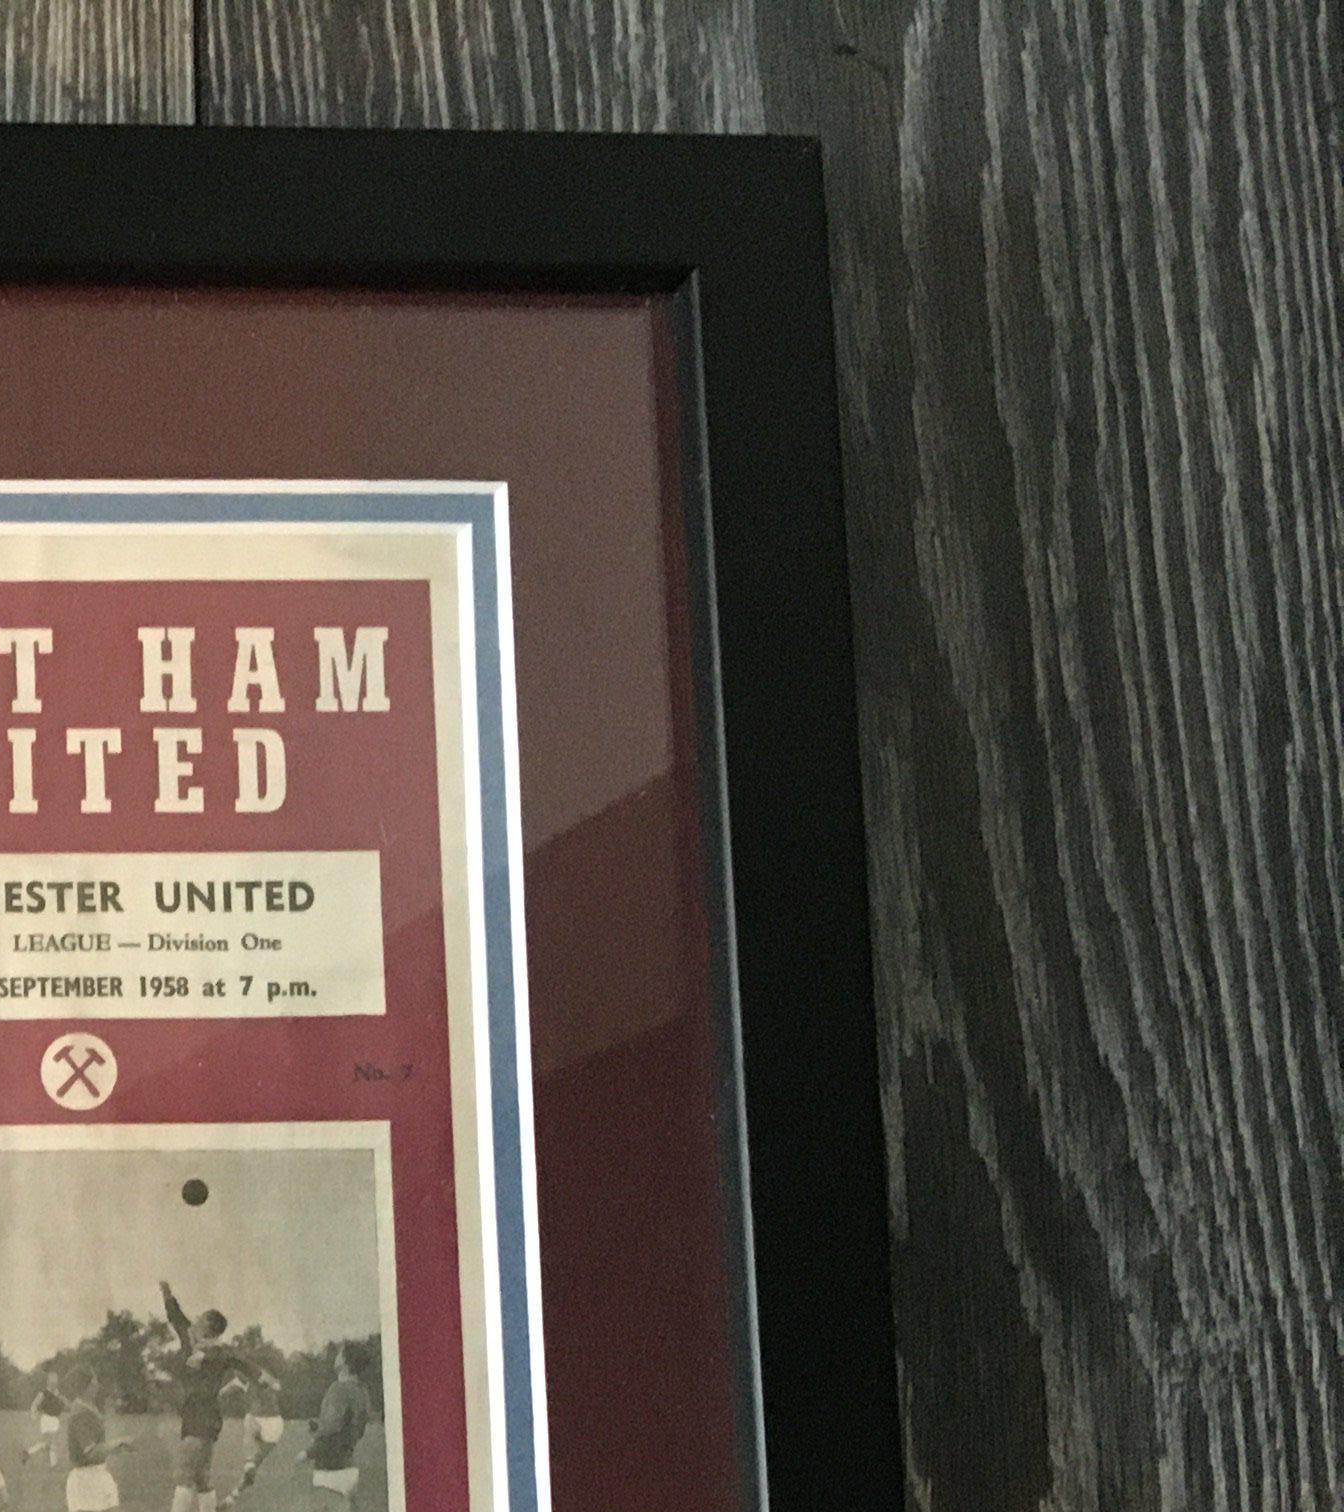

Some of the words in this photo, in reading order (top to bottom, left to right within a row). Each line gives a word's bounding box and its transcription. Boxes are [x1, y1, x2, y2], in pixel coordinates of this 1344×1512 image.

[136, 625, 392, 714] HAM
[153, 878, 316, 914] UNITED
[13, 932, 112, 953] LEAGUE
[147, 932, 230, 953] Division
[239, 932, 283, 952] One
[138, 975, 190, 999] 1958
[201, 978, 227, 999] at
[238, 974, 255, 997] 7
[266, 979, 318, 1004] p.m.
